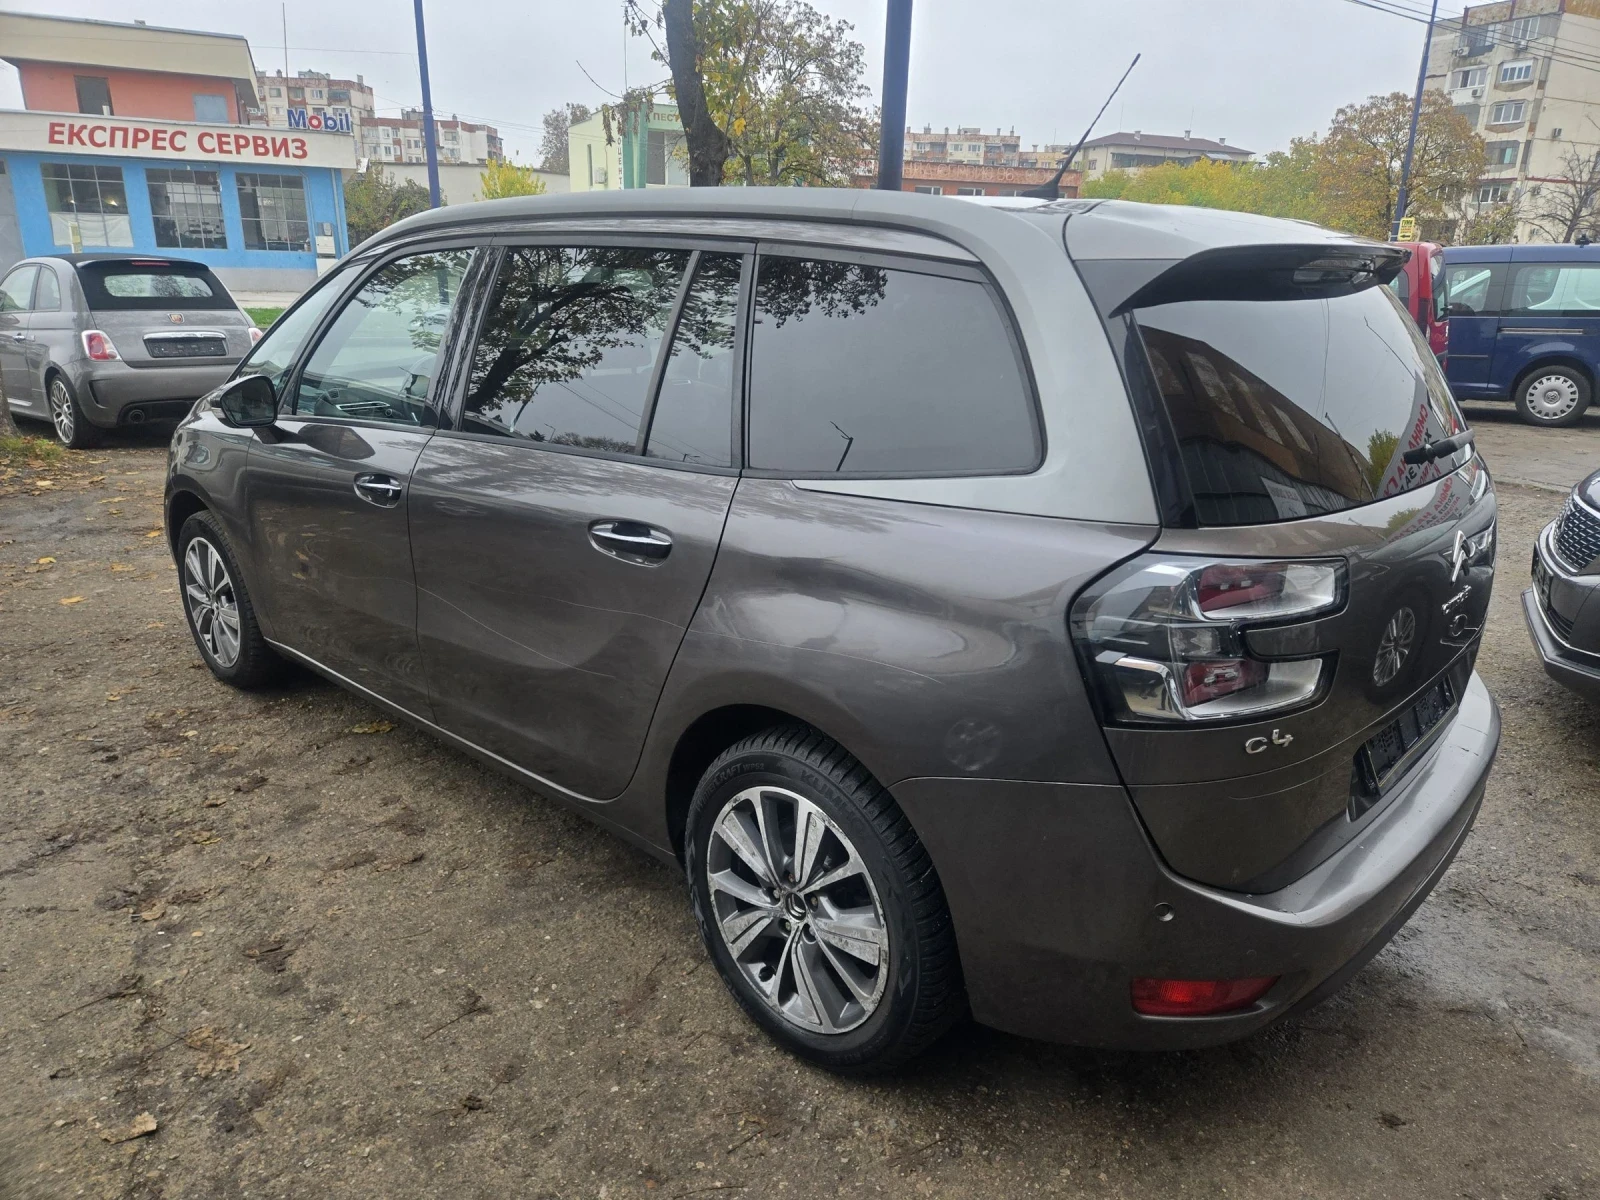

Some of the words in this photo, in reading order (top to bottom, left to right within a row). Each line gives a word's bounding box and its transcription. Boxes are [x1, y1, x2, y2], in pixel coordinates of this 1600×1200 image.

[287, 108, 351, 132] Mobil
[48, 121, 187, 152] ЕКСПРЕС
[197, 131, 308, 159] СЕРВИЗ
[1245, 729, 1294, 754] C4
